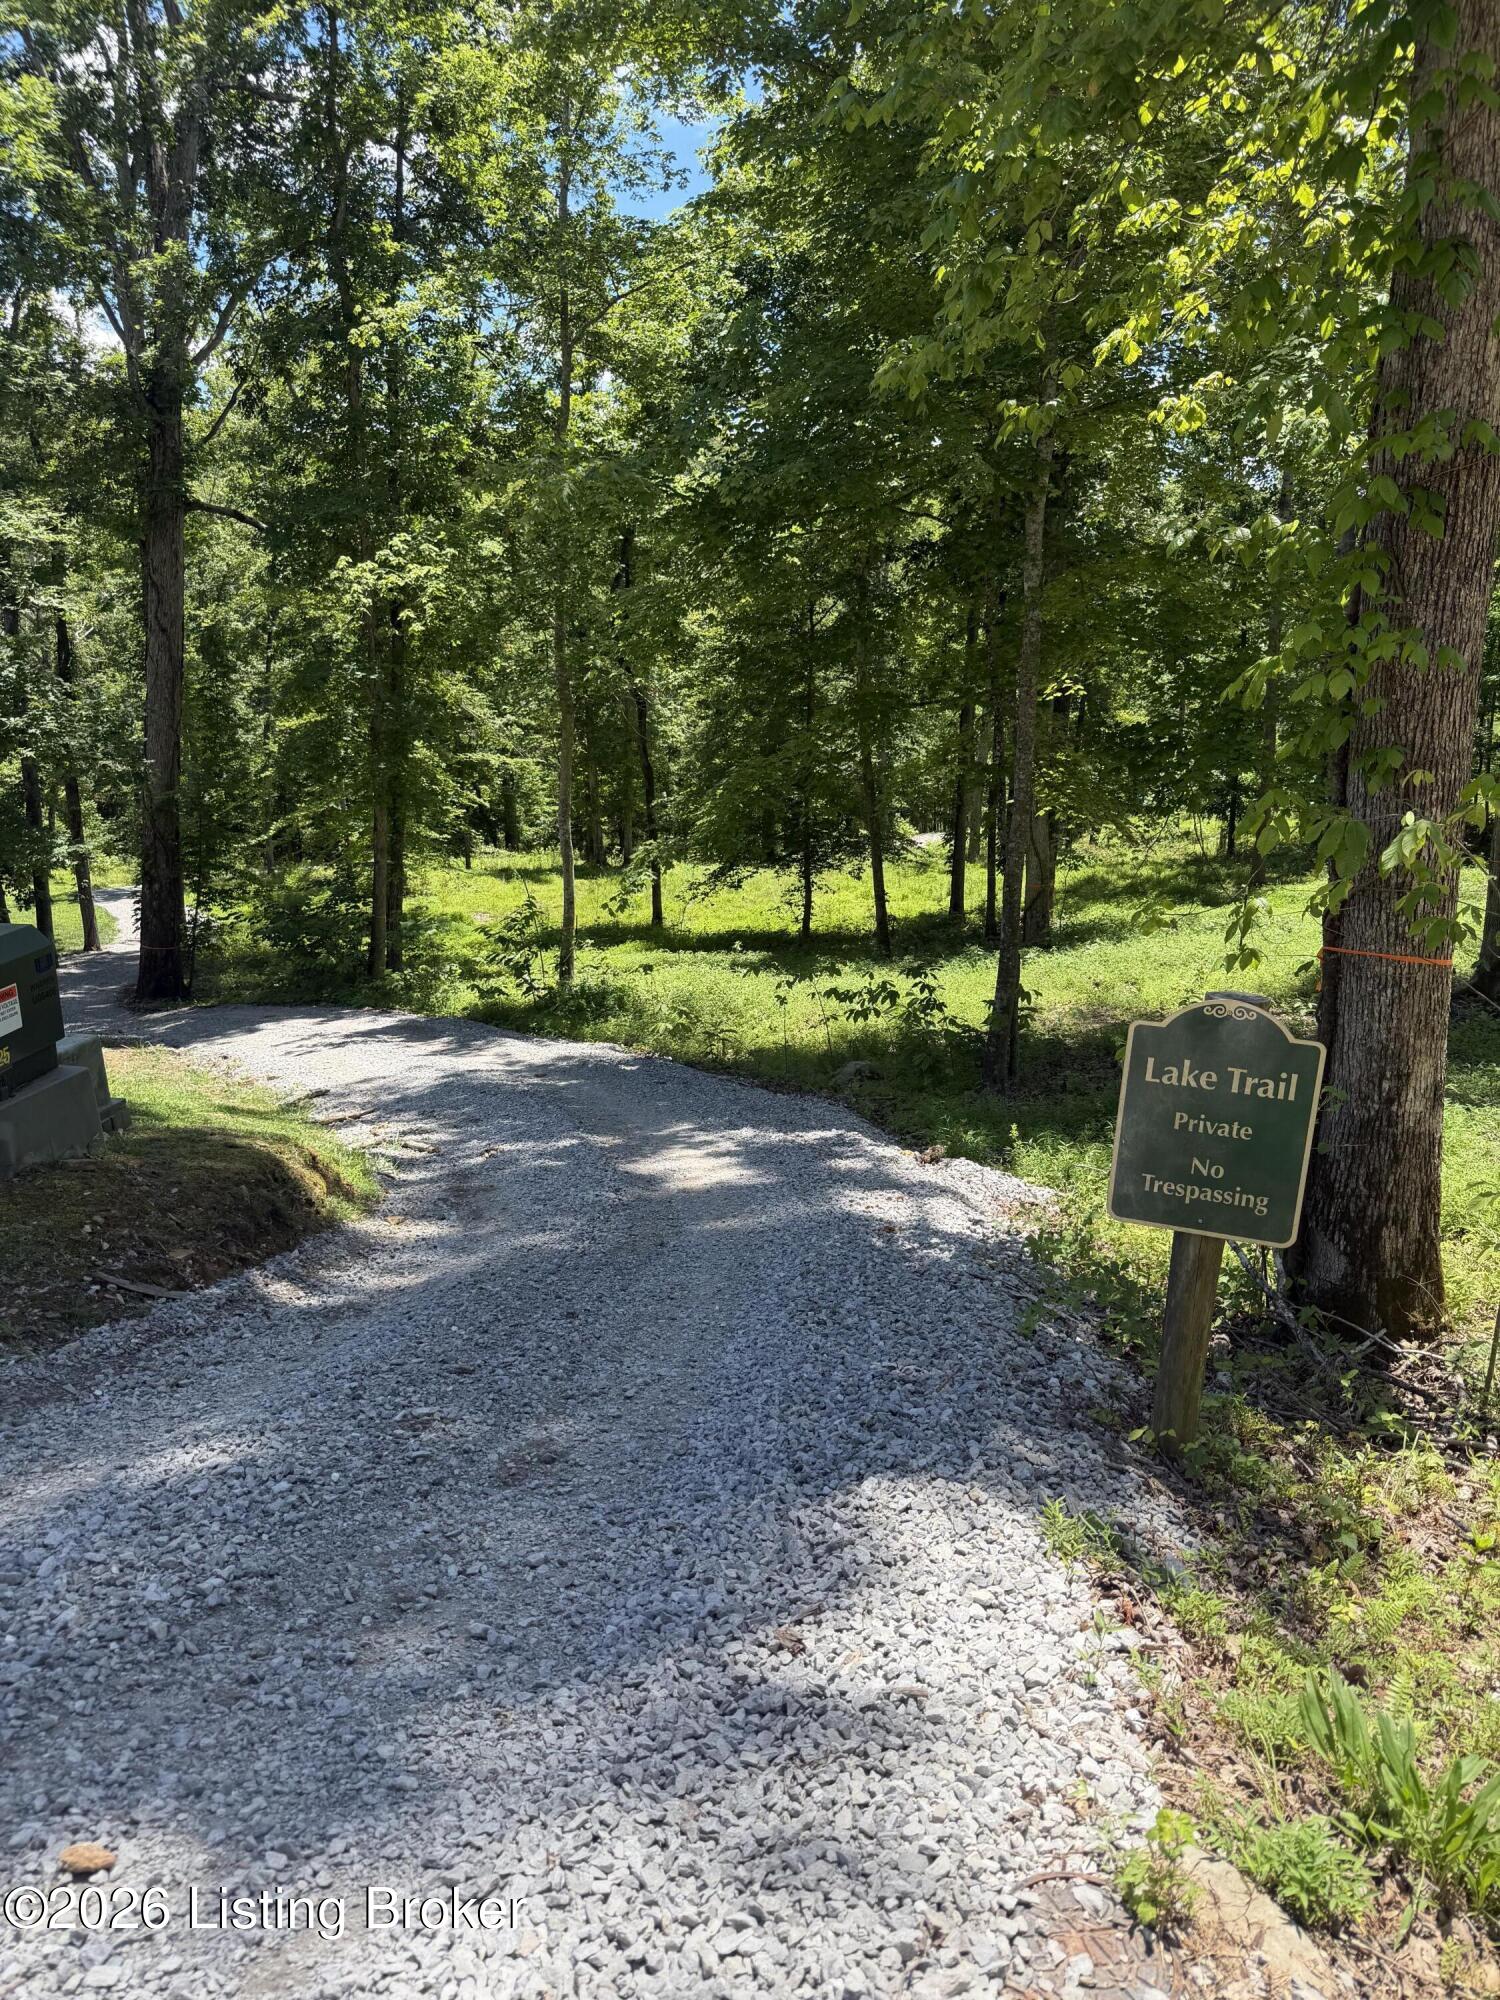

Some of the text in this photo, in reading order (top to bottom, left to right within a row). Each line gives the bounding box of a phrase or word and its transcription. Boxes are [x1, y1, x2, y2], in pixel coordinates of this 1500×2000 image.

[1145, 1057, 1298, 1101] Lake Trail
[1174, 1111, 1253, 1140] Private
[1190, 1157, 1225, 1179] No
[1141, 1173, 1270, 1216] Trespassing
